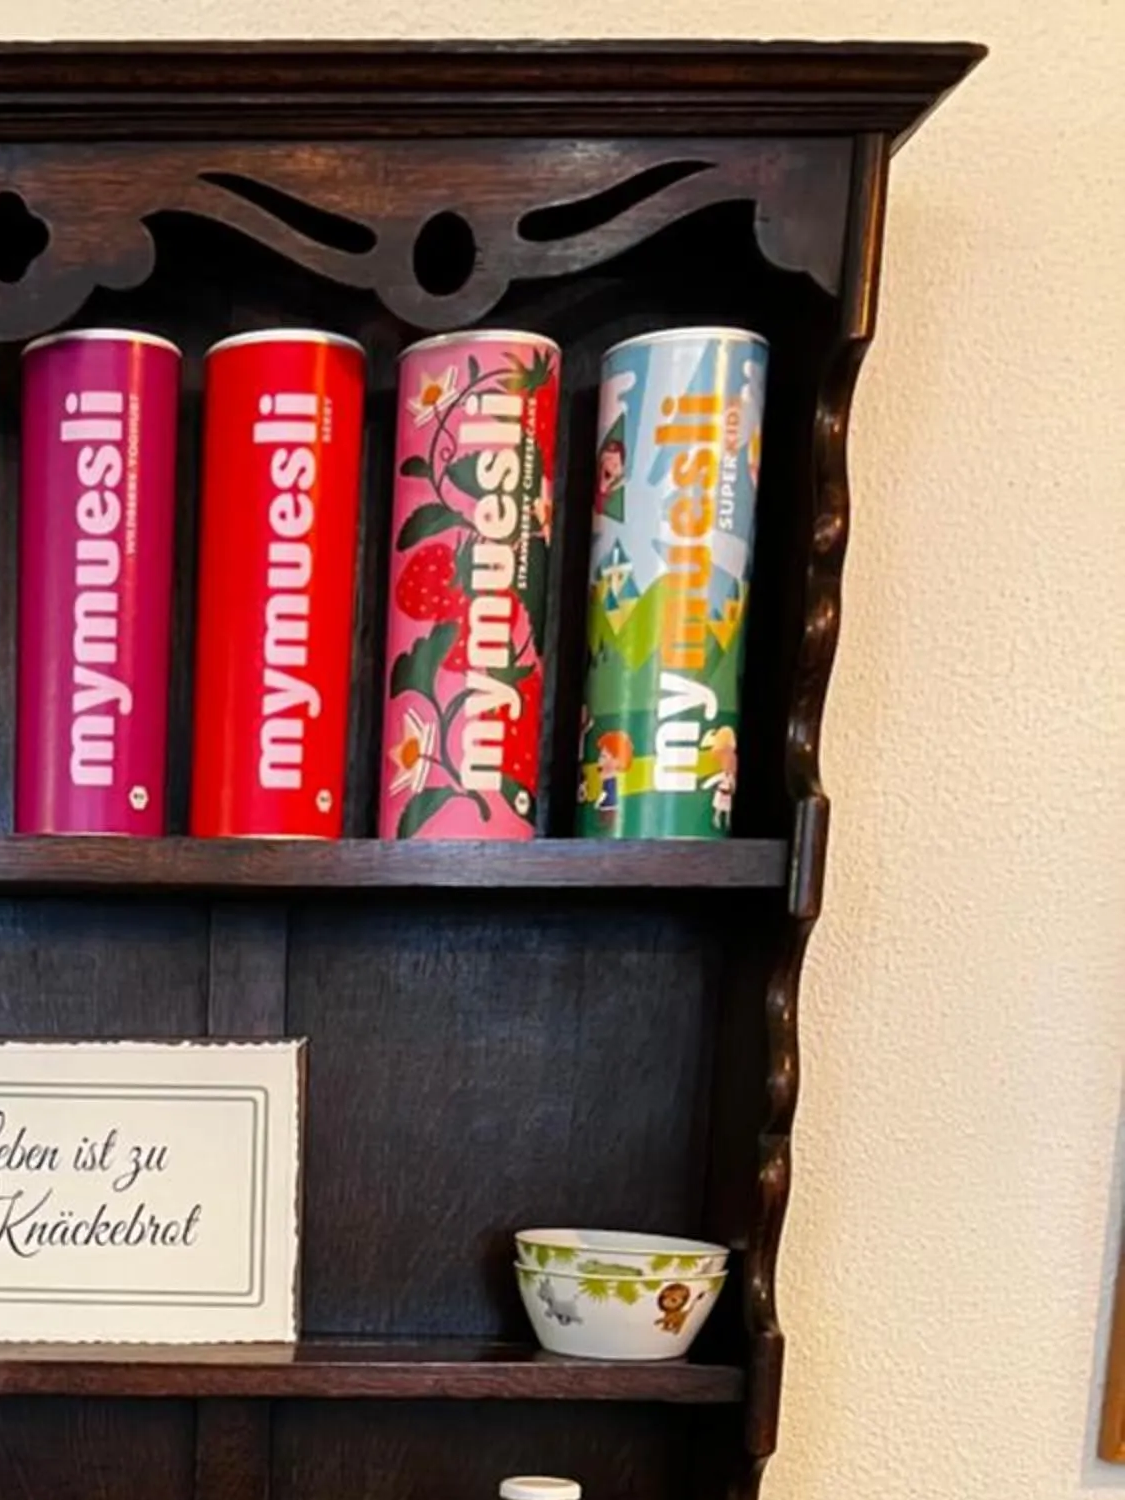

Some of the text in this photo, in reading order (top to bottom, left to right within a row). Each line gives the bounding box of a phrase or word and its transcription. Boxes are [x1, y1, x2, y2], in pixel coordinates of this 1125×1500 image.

[61, 391, 132, 786] mymuesli
[253, 392, 321, 789] mymuesli
[458, 393, 522, 791] mymuesli
[653, 392, 722, 792] mymuesli
[73, 1128, 117, 1172] ist
[112, 1143, 168, 1193] zu
